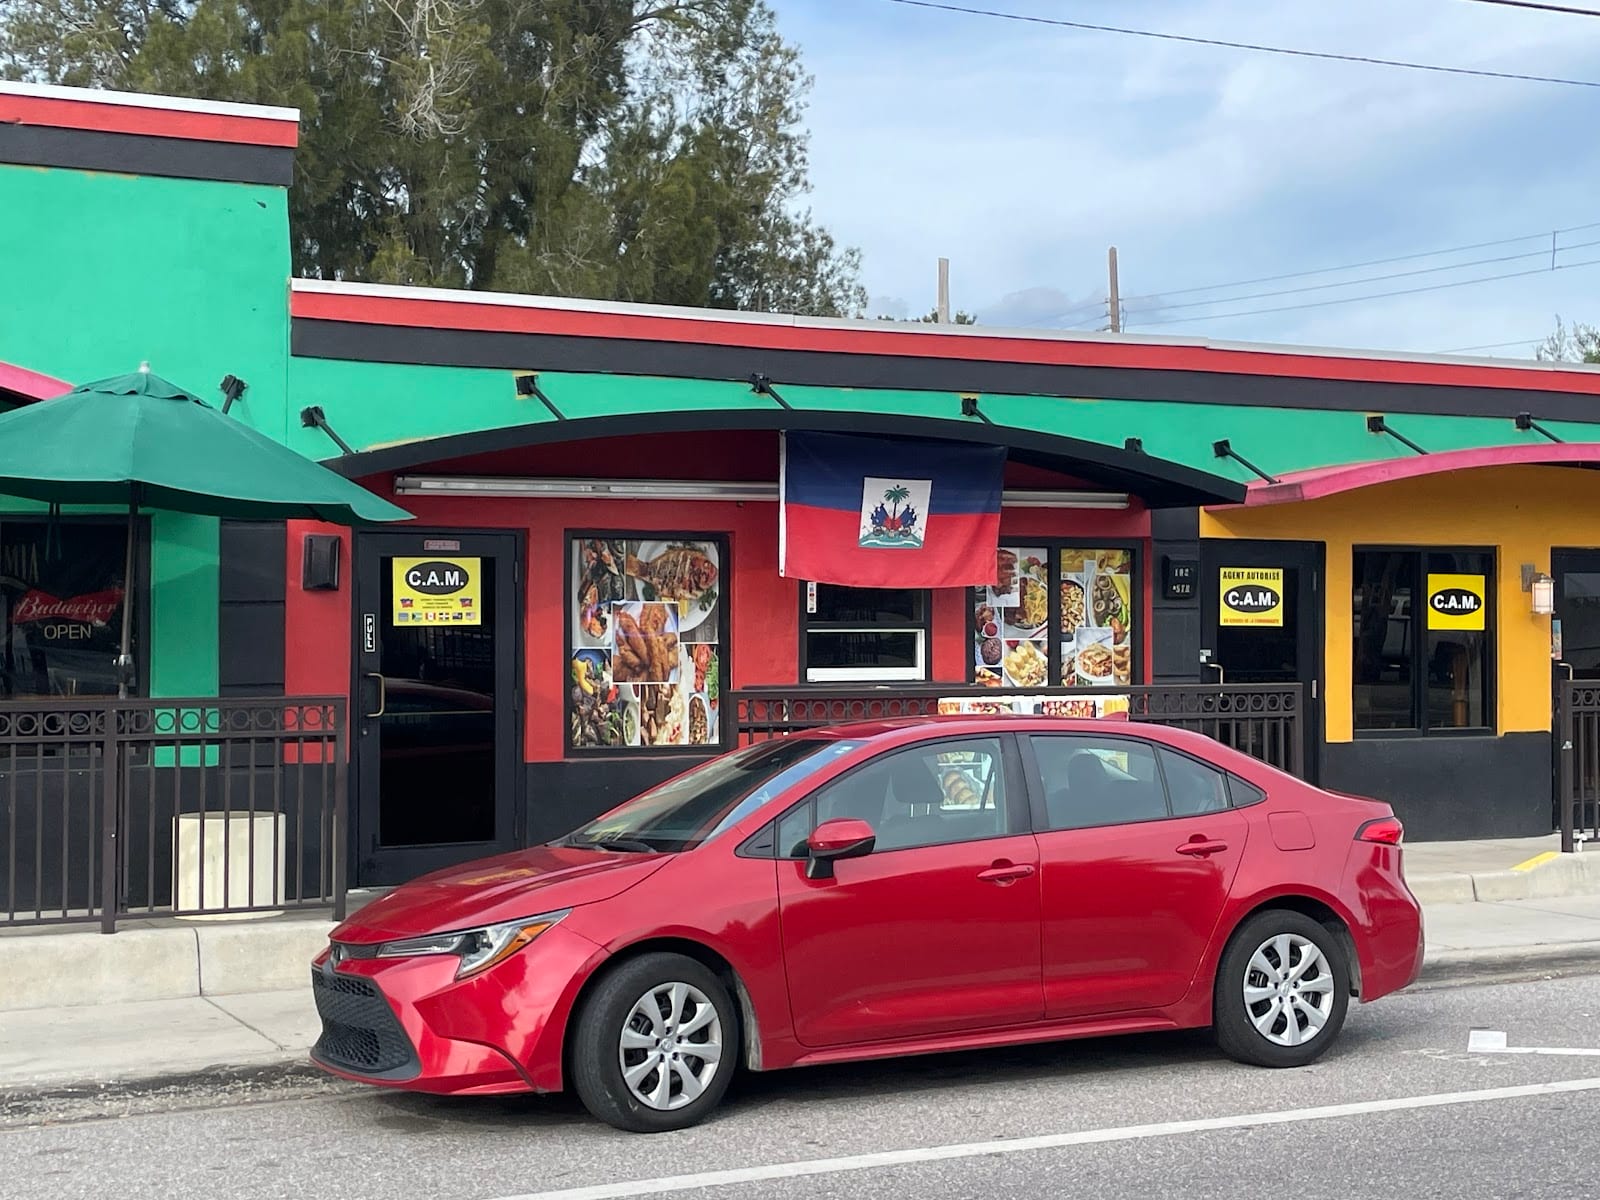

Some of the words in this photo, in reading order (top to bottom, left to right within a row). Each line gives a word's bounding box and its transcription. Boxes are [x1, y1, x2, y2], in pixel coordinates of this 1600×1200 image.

[408, 571, 465, 587] C.A.M.
[1222, 571, 1245, 580] AGENT
[16, 597, 118, 616] Budweiser
[1227, 591, 1276, 606] C.A.M.
[1433, 594, 1479, 610] C.A.M.
[43, 624, 92, 640] OPEN
